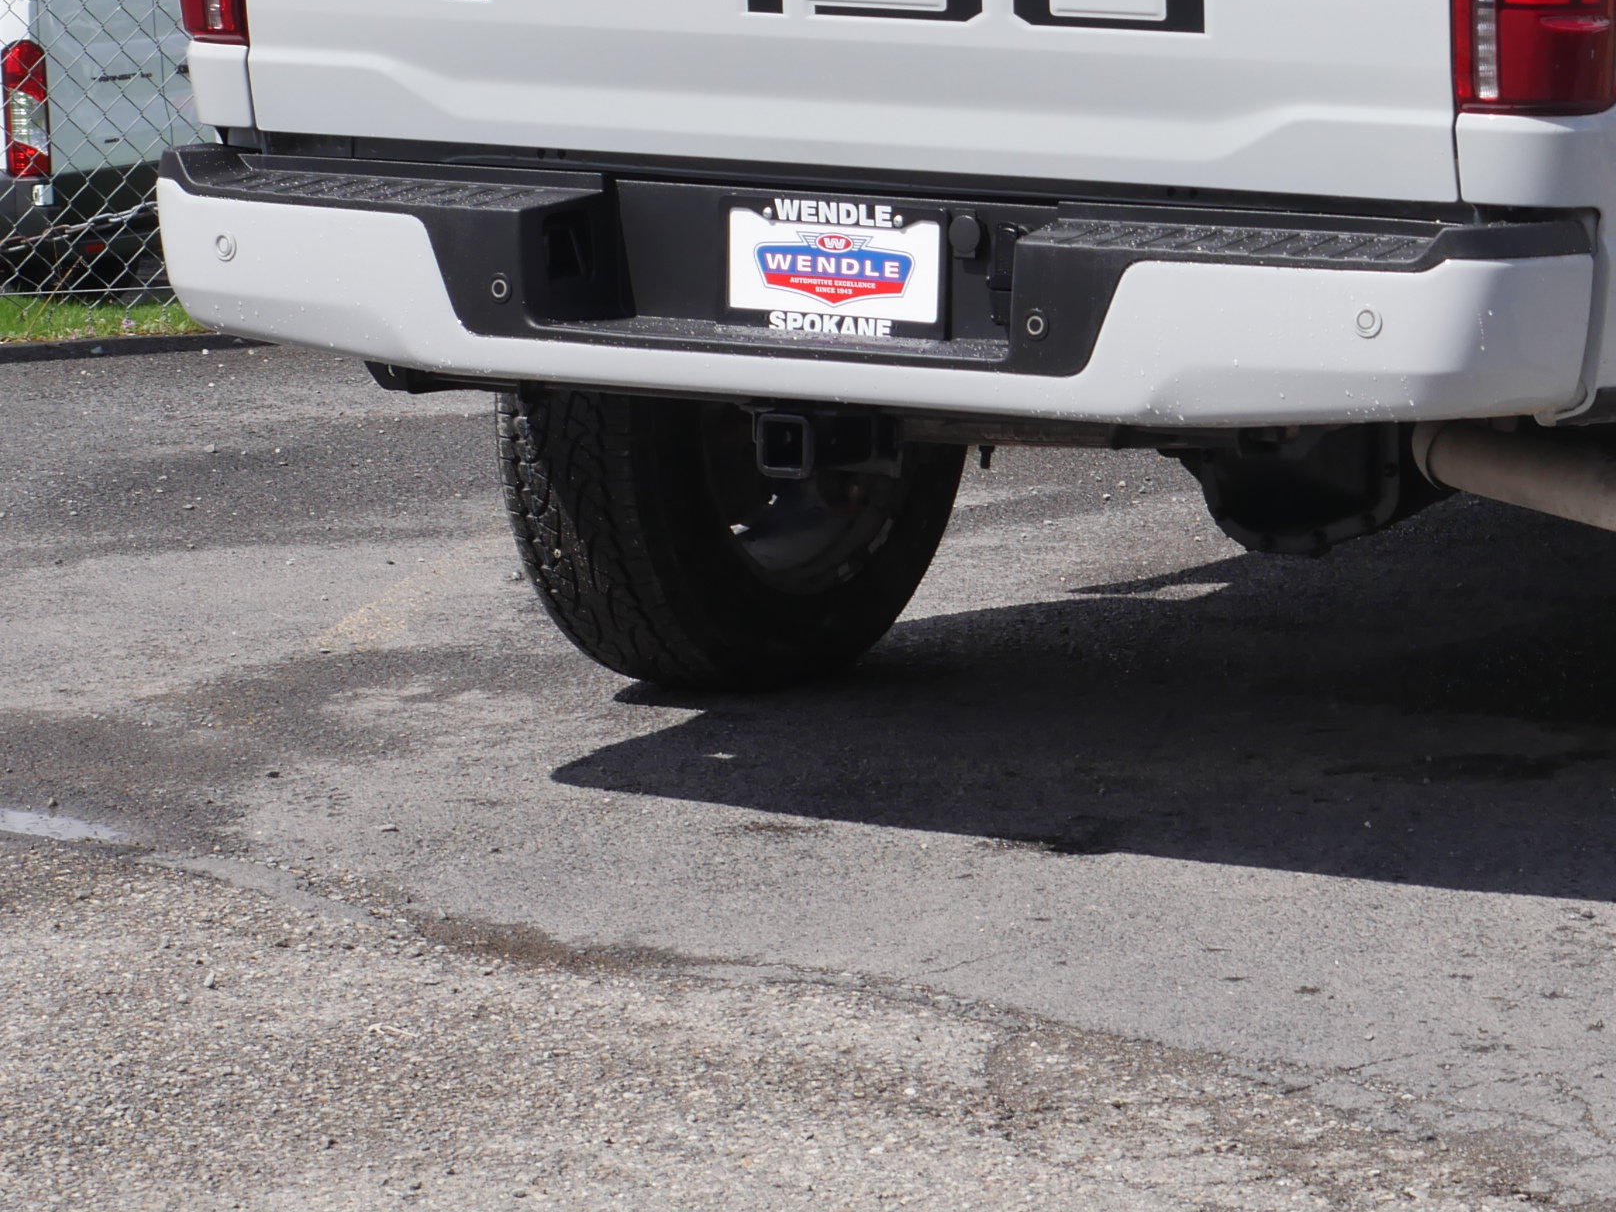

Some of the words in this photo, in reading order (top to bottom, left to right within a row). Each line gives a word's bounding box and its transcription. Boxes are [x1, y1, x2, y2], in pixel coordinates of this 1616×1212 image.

[774, 198, 893, 228] WENDLE
[822, 237, 847, 250] W
[765, 252, 900, 278] WENDLE
[789, 276, 833, 286] AUTOMOTIVE
[834, 279, 876, 289] EXCELLENCE
[815, 286, 836, 294] SINCE
[769, 310, 892, 338] SPOKANE
